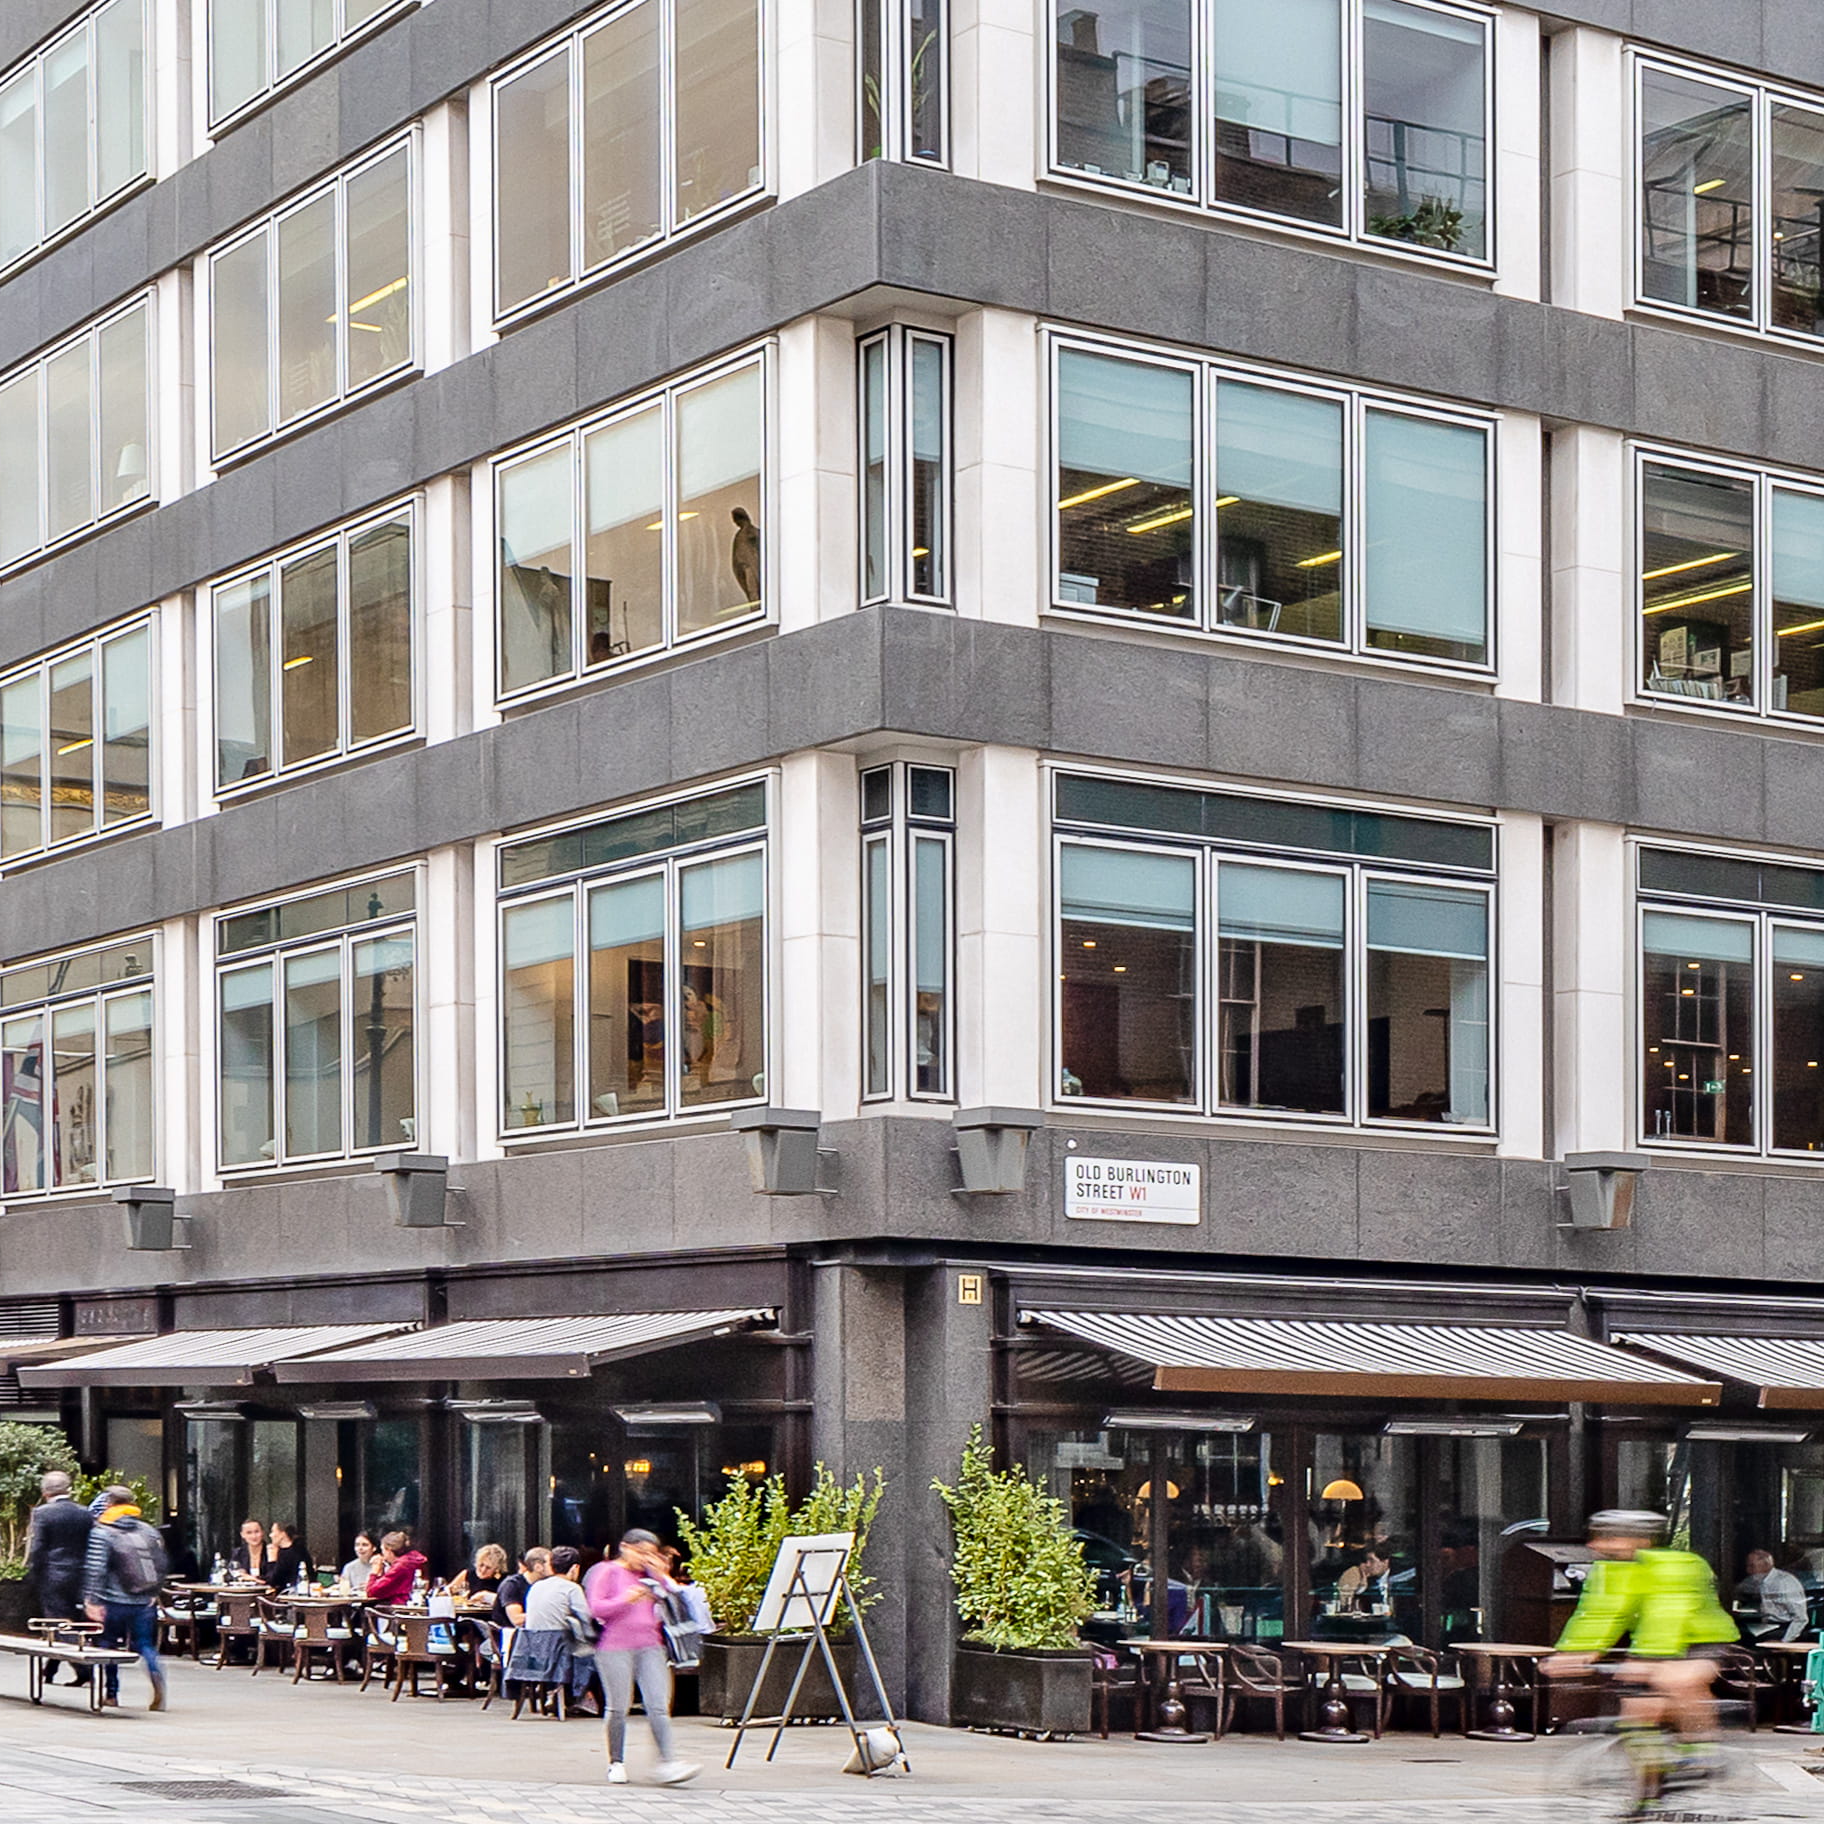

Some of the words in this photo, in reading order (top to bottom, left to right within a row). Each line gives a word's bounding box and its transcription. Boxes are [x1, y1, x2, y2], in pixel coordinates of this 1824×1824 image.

[1076, 1164, 1101, 1180] OLD
[1107, 1166, 1192, 1186] BURLINGTON
[1076, 1183, 1124, 1199] STREET
[1129, 1186, 1148, 1201] W1
